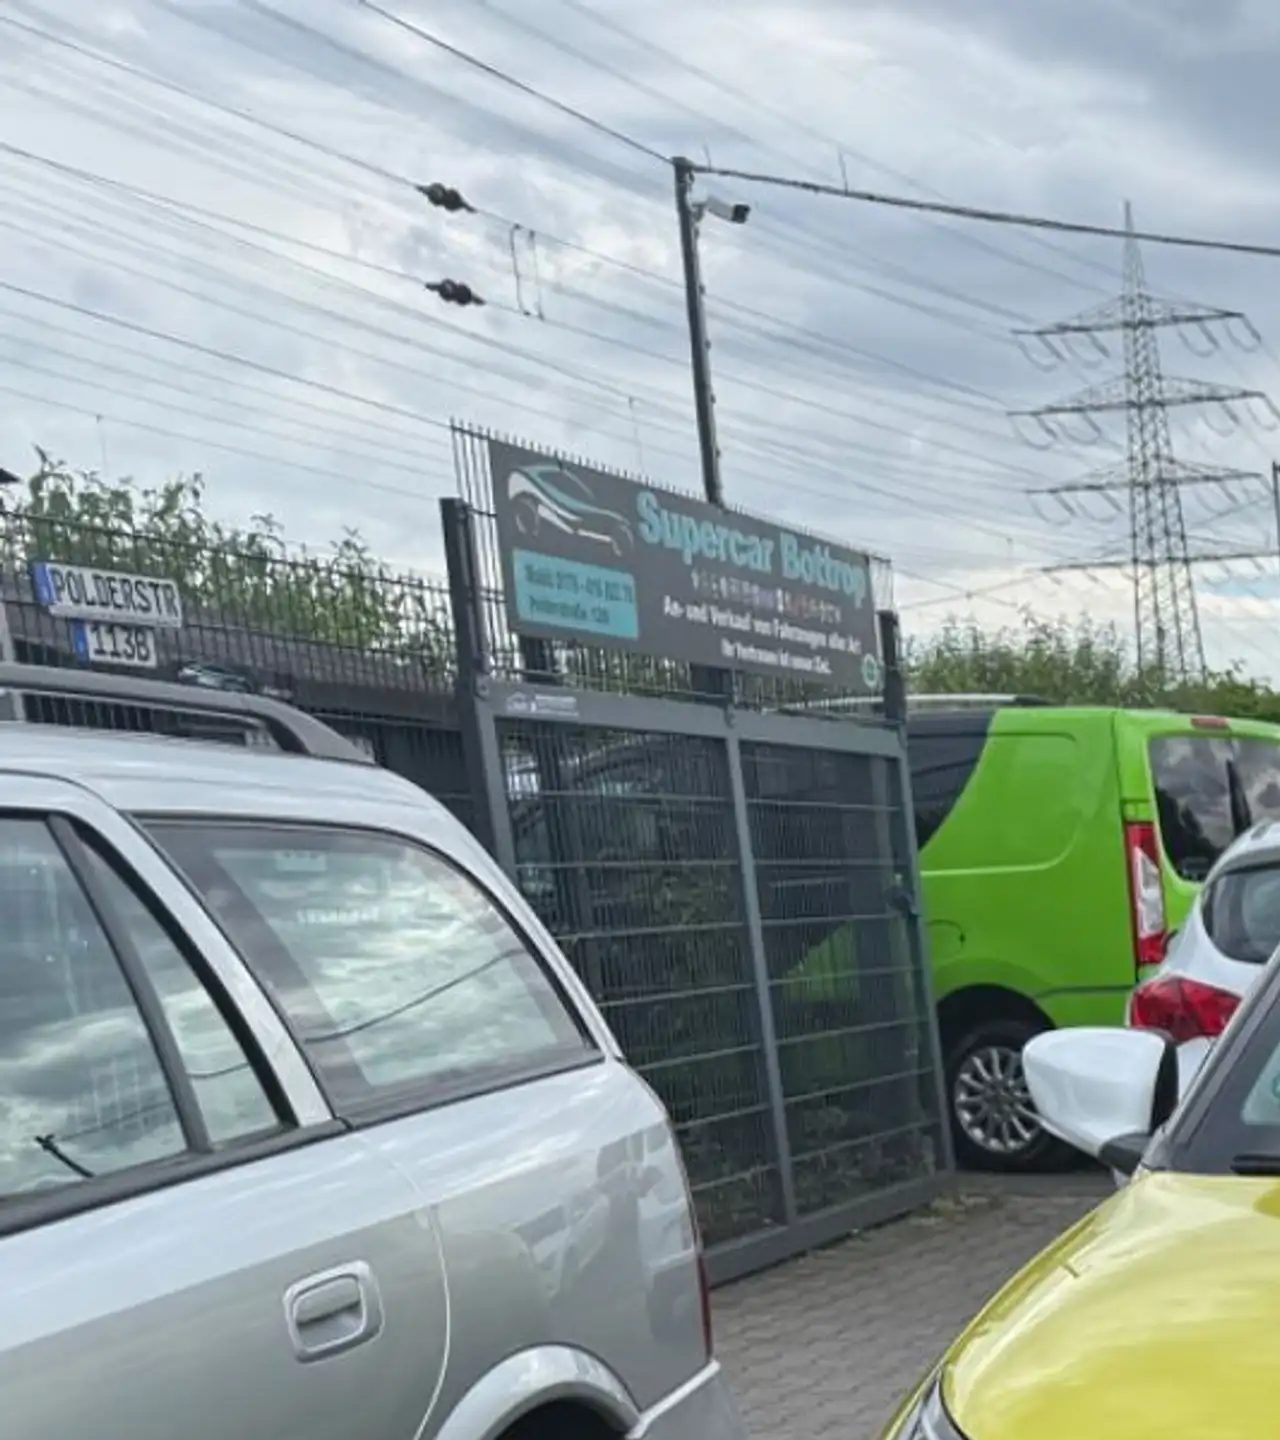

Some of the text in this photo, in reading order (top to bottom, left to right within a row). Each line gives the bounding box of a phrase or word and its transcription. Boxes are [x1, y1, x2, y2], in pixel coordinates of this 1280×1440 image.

[51, 567, 179, 617] POLDERSTR
[637, 491, 775, 574] Supercar
[779, 531, 867, 610] Bottrop
